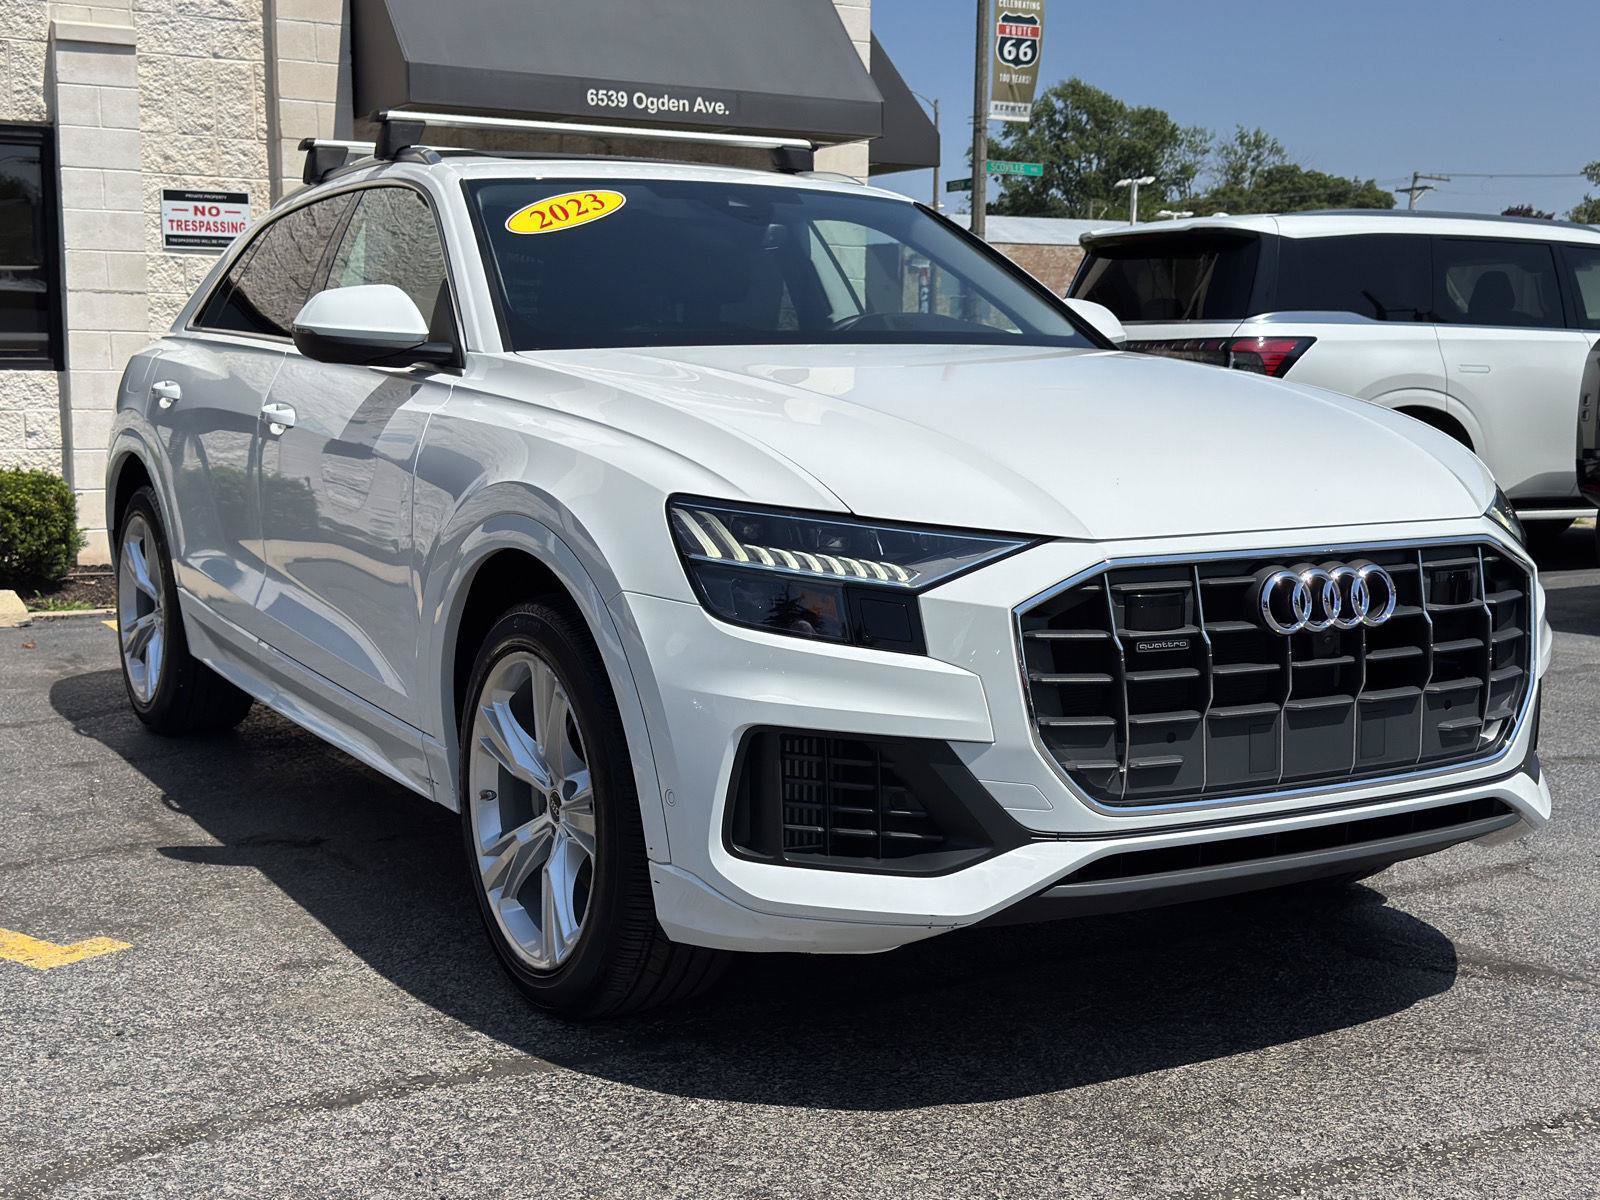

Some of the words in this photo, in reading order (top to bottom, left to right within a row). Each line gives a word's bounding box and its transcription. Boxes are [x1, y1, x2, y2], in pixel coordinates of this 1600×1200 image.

[999, 0, 1040, 10] CELEBRATING
[1005, 25, 1032, 36] ROUTE
[1003, 39, 1032, 61] 66
[1000, 73, 1011, 83] 100
[587, 89, 628, 108] 6539
[633, 92, 690, 114] Ogden
[693, 96, 730, 115] Ave.
[991, 162, 1025, 173] SCOVILLE
[193, 205, 221, 217] NO
[529, 193, 605, 229] 2023
[168, 219, 246, 234] TRESPASSING
[1140, 641, 1187, 650] quattro
